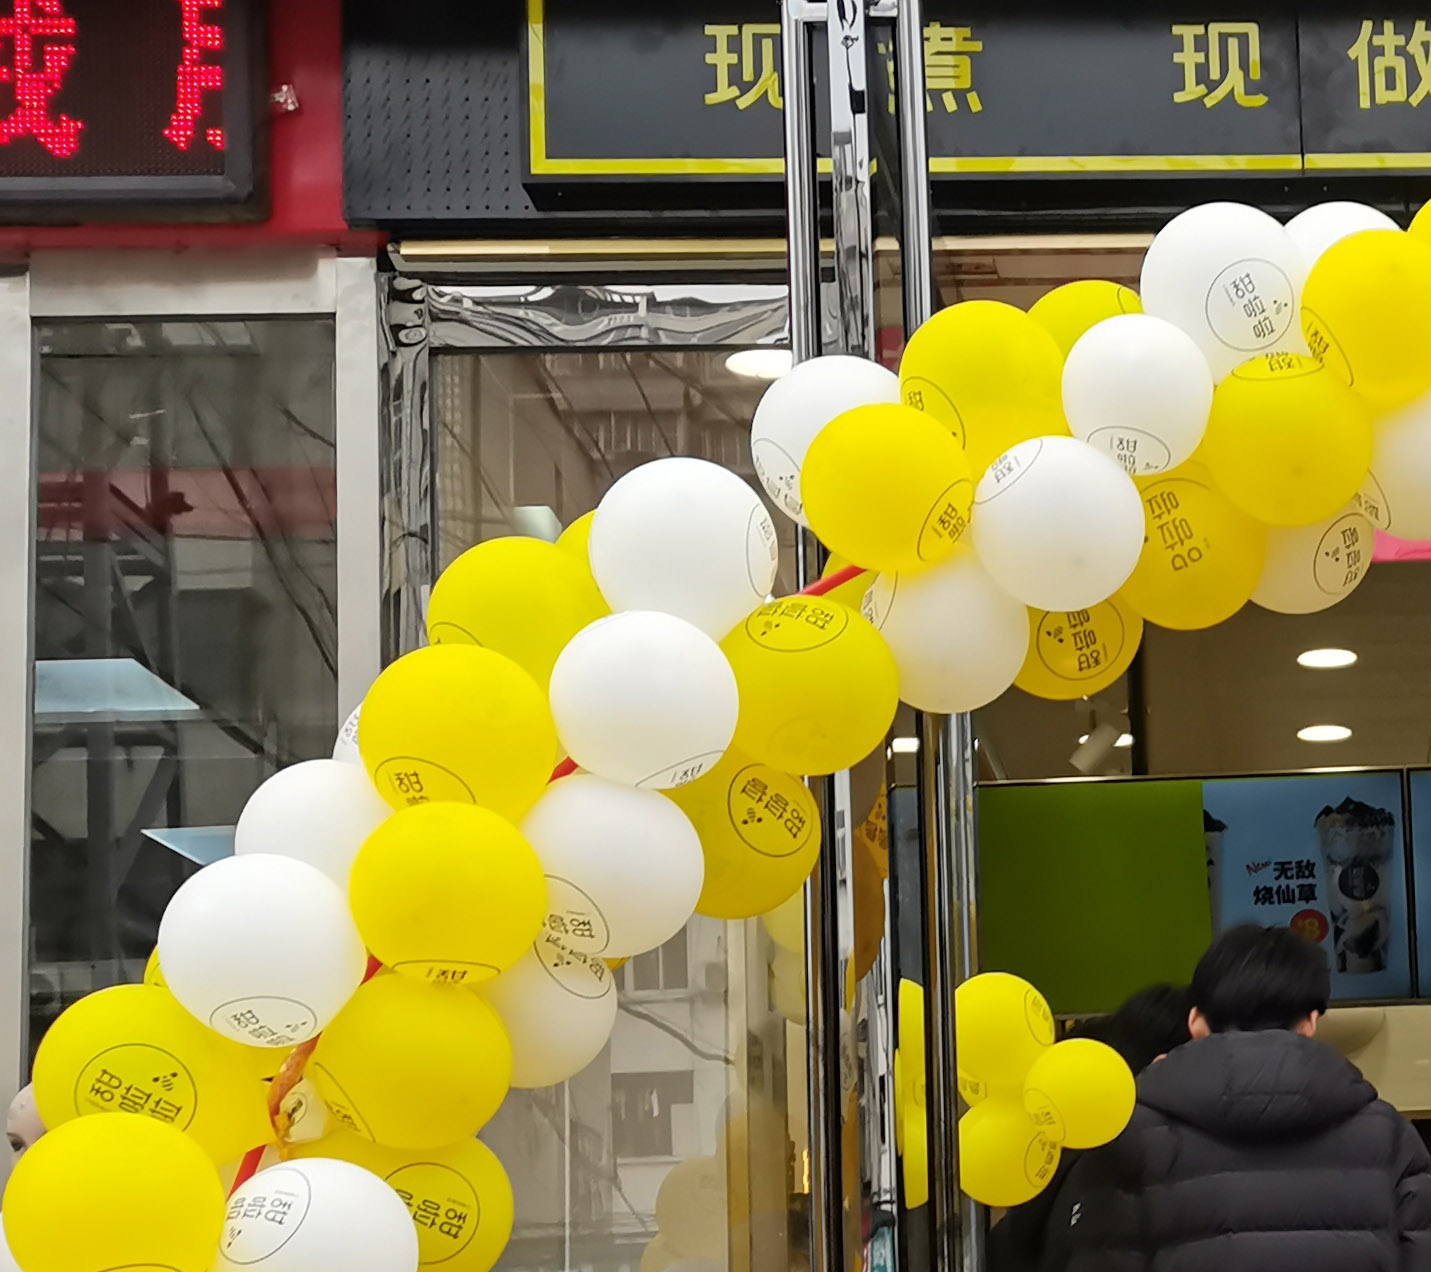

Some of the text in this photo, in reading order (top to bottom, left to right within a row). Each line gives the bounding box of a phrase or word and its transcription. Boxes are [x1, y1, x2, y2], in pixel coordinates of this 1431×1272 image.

[1229, 272, 1276, 339] 甜啦啦
[1273, 859, 1316, 880] 无敌
[1253, 884, 1317, 905] 烧仙草
